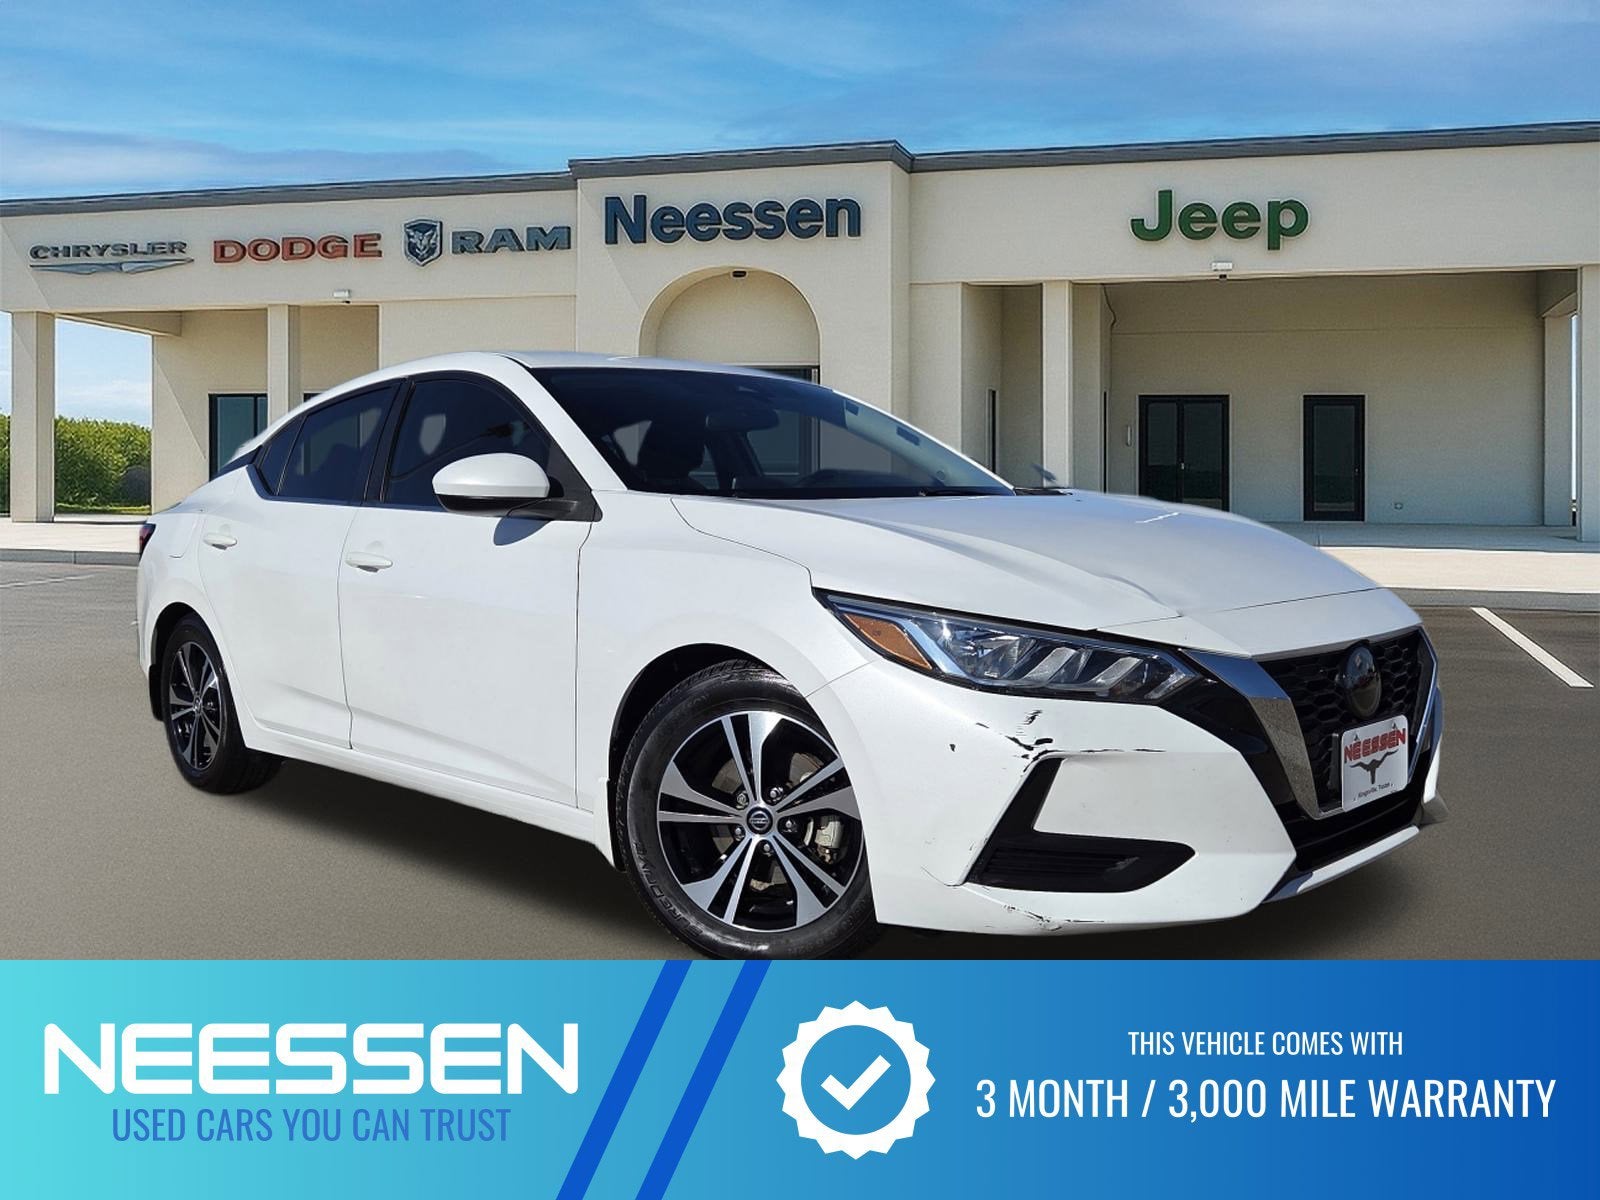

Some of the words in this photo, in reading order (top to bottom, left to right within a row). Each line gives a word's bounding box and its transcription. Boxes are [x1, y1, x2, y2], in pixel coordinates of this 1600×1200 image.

[604, 195, 862, 245] Neessen
[1130, 190, 1309, 250] Jeep
[29, 241, 188, 259] CHRYSLER
[213, 233, 384, 264] DODGE
[451, 225, 572, 256] RAM
[1344, 728, 1406, 763] NEESSEN
